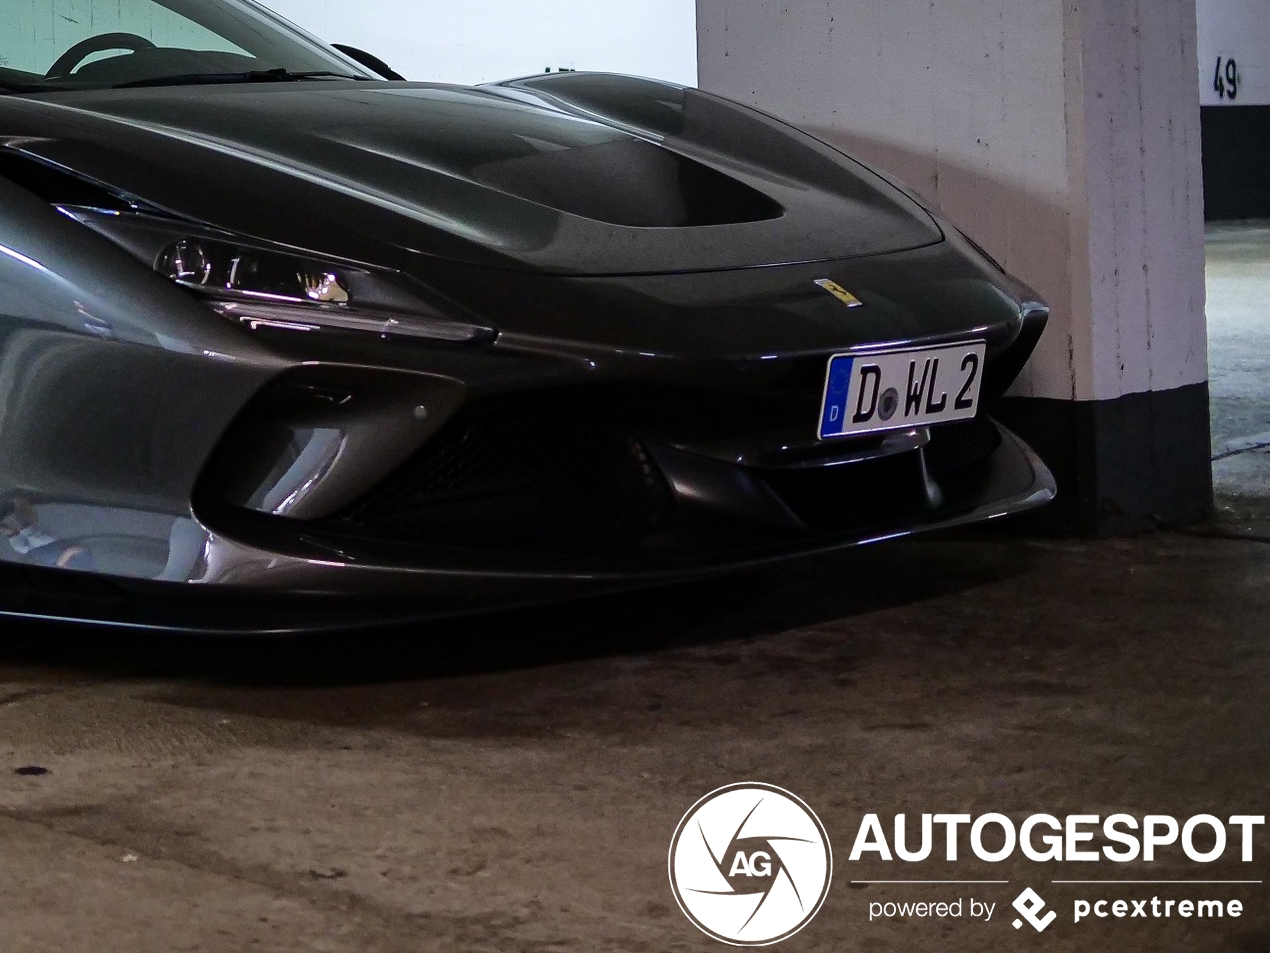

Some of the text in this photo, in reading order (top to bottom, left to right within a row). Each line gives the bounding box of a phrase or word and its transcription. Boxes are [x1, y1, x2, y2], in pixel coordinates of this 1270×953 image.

[1213, 56, 1237, 100] 49
[852, 352, 979, 424] D WL 2
[830, 405, 839, 422] D
